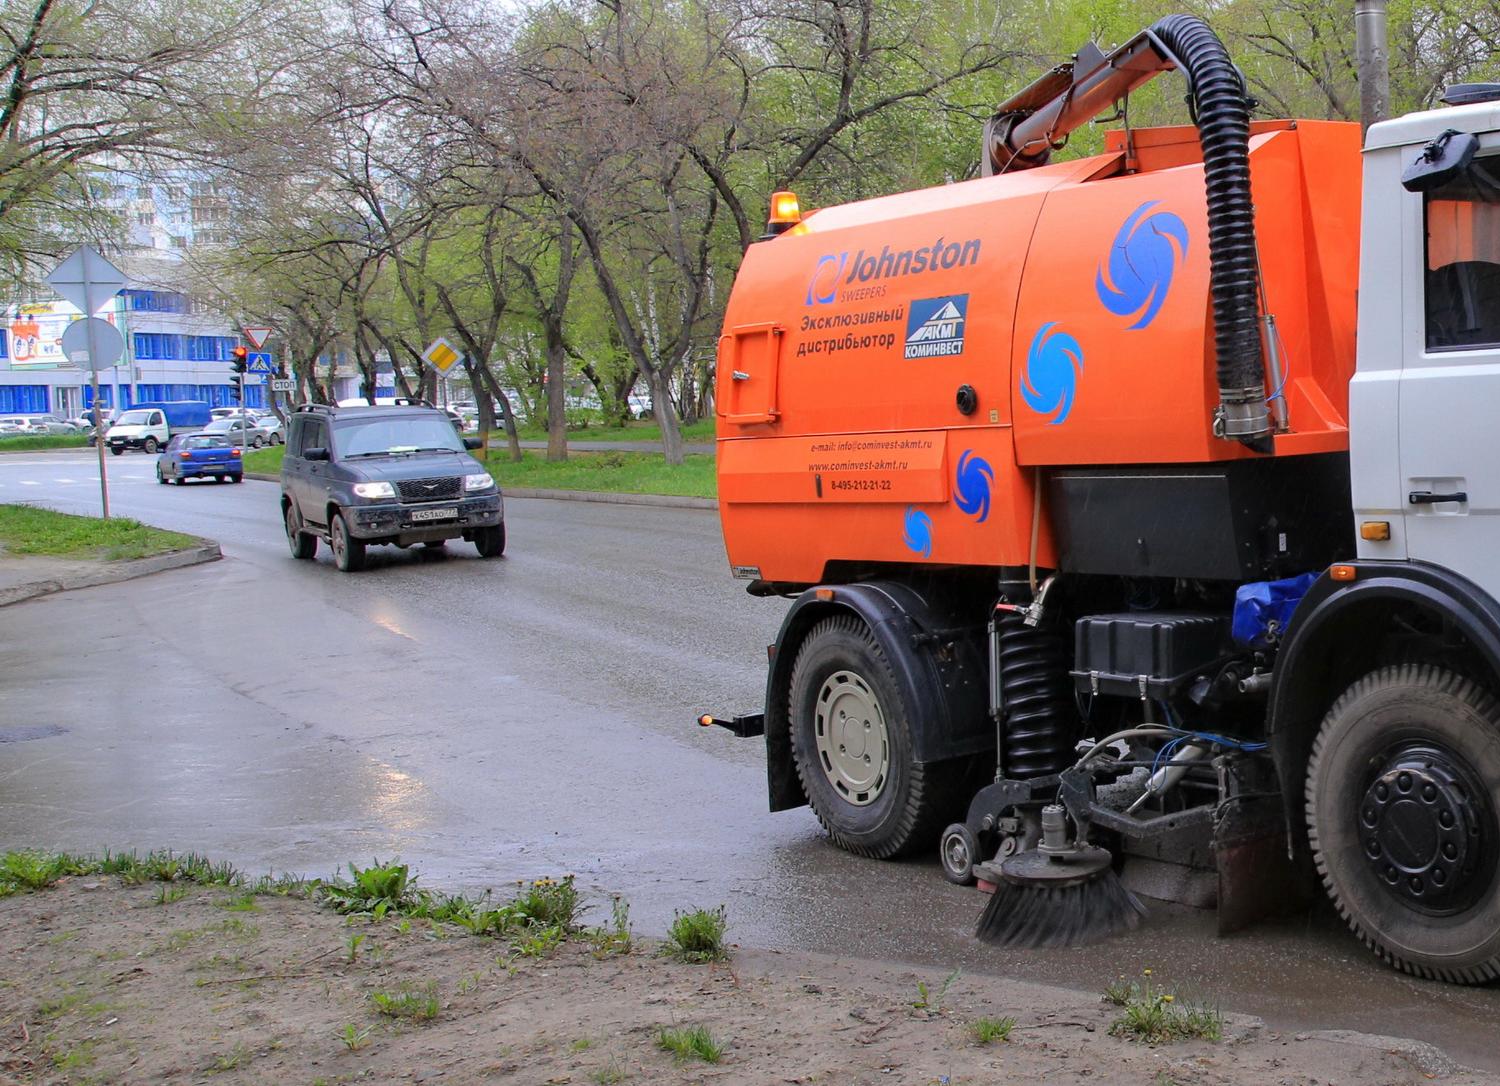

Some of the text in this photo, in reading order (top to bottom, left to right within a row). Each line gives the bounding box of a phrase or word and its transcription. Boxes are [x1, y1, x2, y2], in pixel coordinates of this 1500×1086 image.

[846, 237, 981, 284] Johnston
[841, 285, 887, 303] SWEEPERS
[801, 304, 903, 331] Эксклюзивный
[922, 318, 964, 340] АКМТ
[797, 333, 895, 357] дистрибьютор
[905, 340, 963, 359] КОМИНВЕСТ
[274, 381, 295, 390] СТОП
[811, 442, 836, 453] e-mail:
[808, 460, 908, 472] www.cominvest-akmt.ru
[831, 480, 892, 490] 8-495-212-21-22
